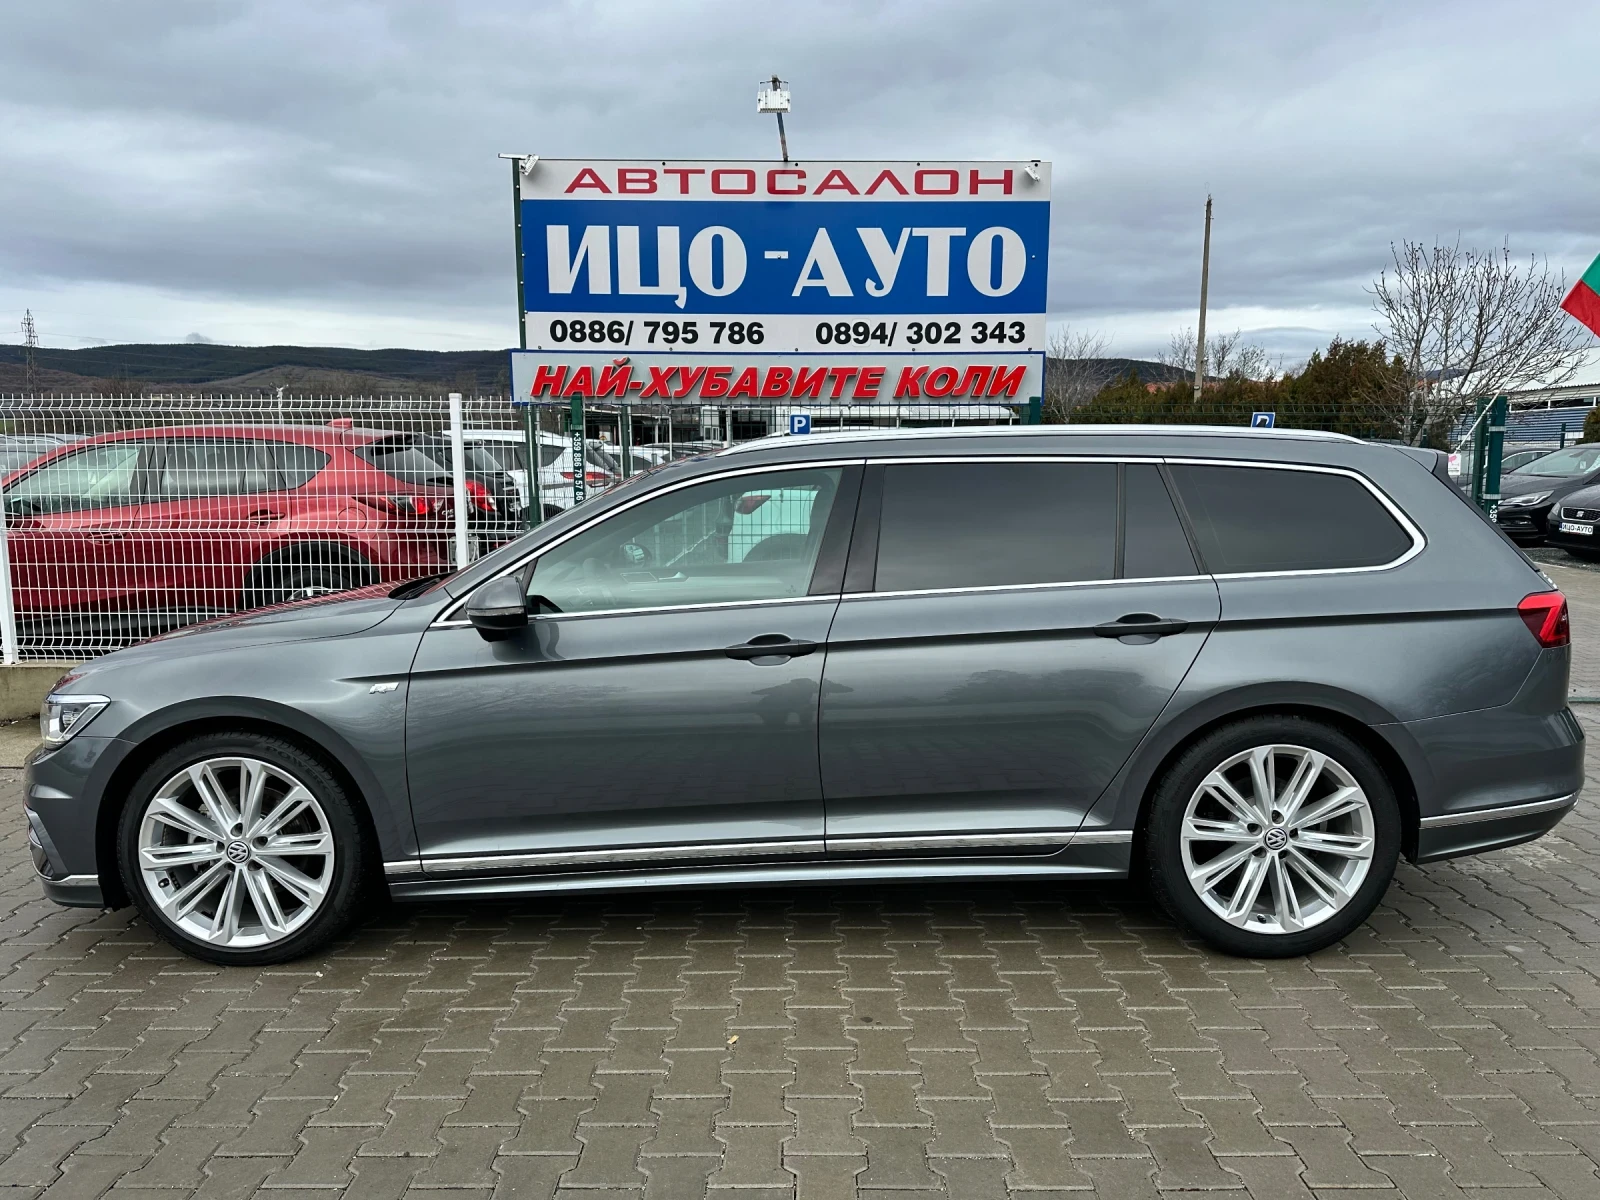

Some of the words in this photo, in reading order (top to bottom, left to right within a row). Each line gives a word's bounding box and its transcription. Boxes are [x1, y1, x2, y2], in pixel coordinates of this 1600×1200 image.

[565, 168, 1014, 196] АВТОСАЛОН
[549, 319, 634, 346] 0886/
[643, 321, 699, 345] 795
[709, 321, 765, 345] 786
[815, 321, 898, 347] 0894/
[906, 321, 962, 345] 302
[970, 321, 1026, 344] 343
[530, 356, 886, 398] НАЙ-ХУБАВИТЕ
[894, 365, 1027, 398] КОЛИ
[793, 416, 807, 433] P
[573, 432, 581, 451] +359
[573, 453, 582, 467] 886
[574, 468, 583, 478] 79
[575, 480, 583, 489] 57
[575, 491, 584, 500] 86
